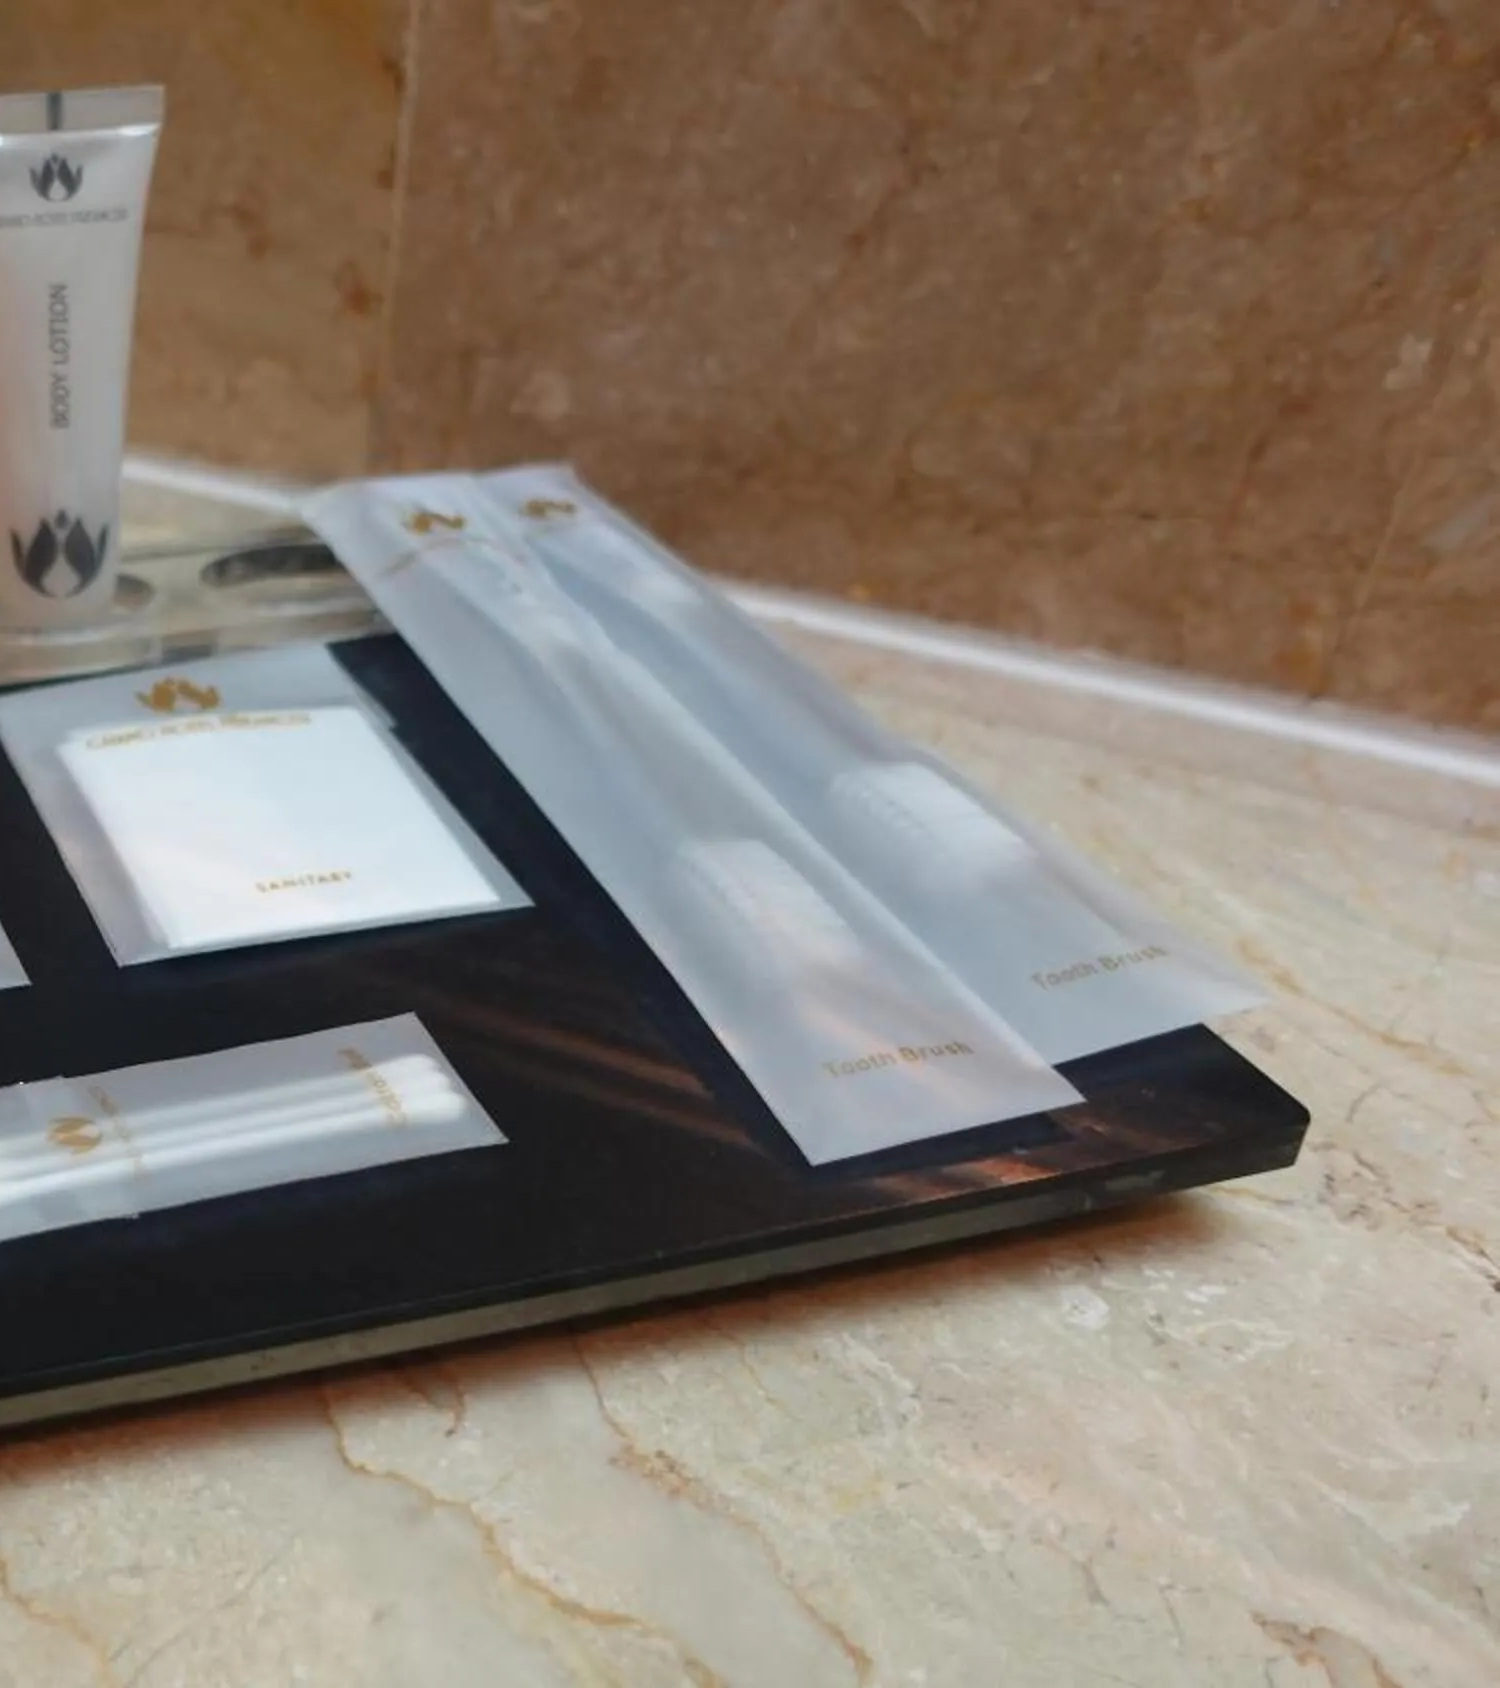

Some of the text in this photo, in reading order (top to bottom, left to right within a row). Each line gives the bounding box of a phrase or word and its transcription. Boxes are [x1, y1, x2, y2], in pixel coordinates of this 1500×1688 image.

[49, 284, 70, 429] BODY LOTION
[254, 869, 353, 894] SANITARY
[1030, 945, 1170, 992] Tooth Brush
[822, 1040, 975, 1078] Tooth Brush
